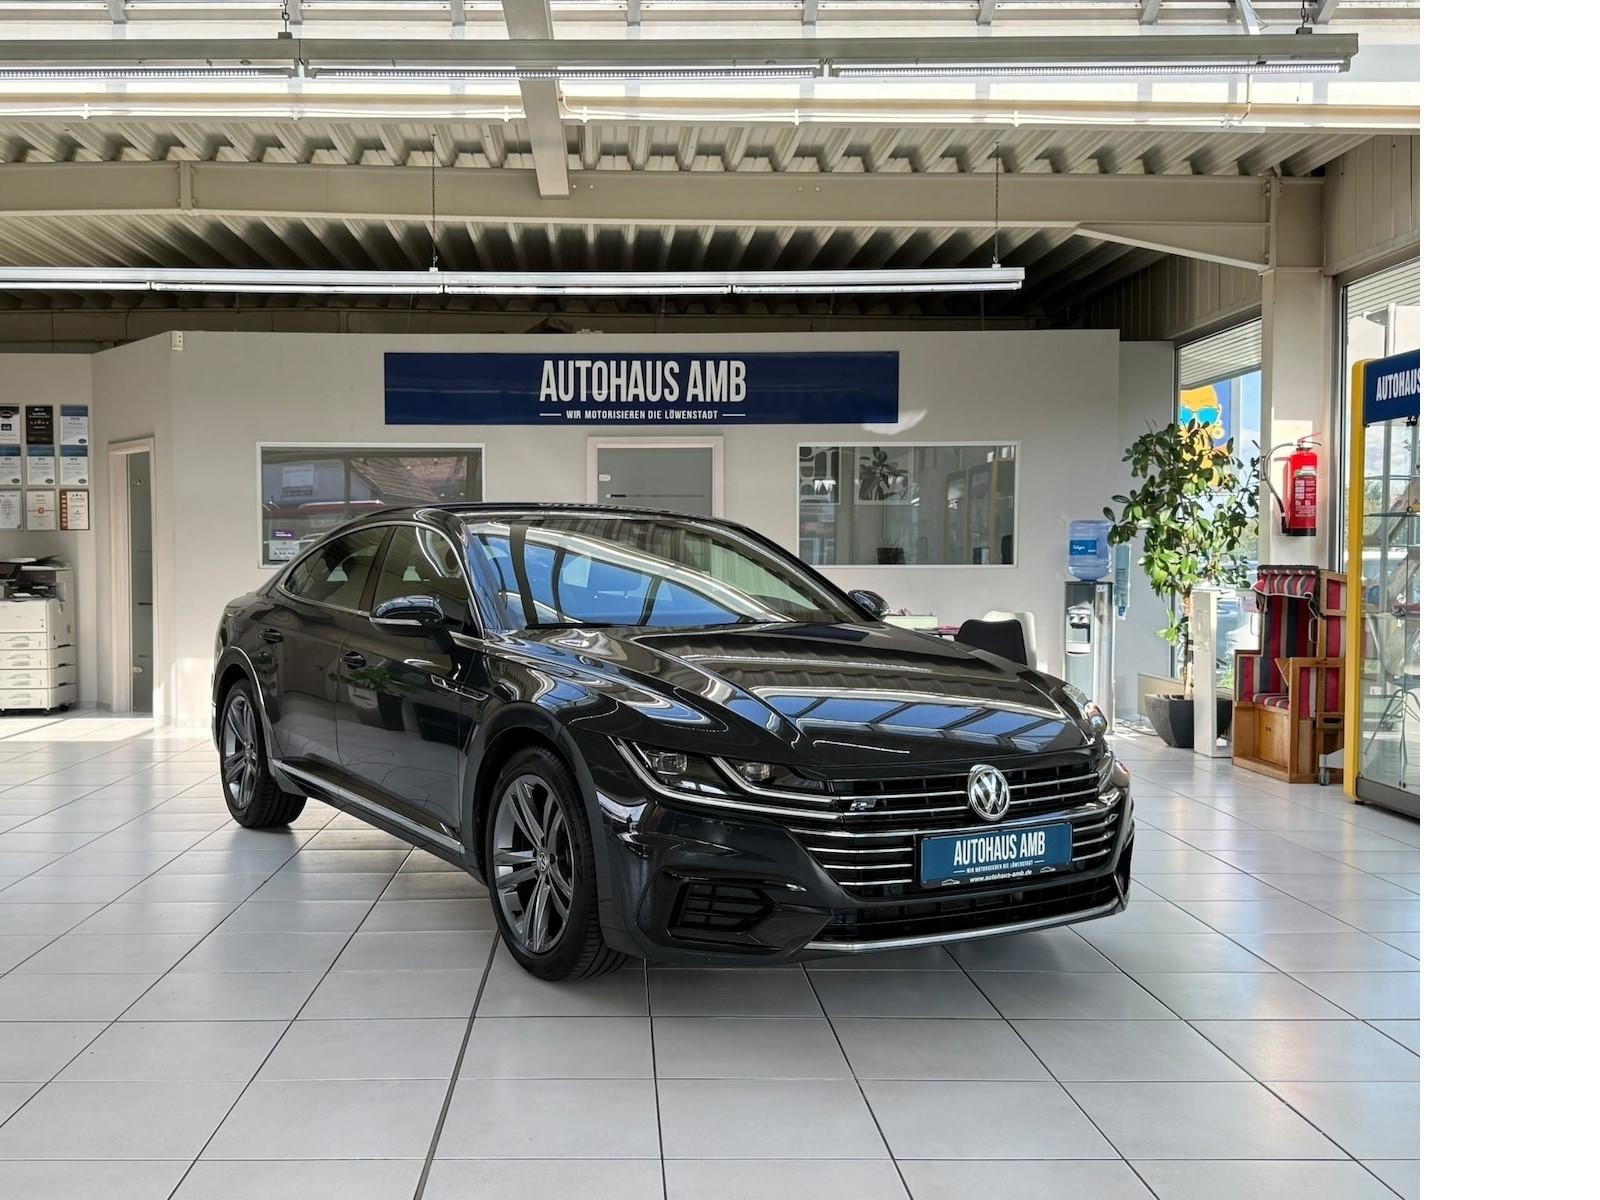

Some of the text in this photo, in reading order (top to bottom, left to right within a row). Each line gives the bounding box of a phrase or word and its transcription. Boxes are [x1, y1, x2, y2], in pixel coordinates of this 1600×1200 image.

[539, 360, 747, 402] AUTOHAUS AMB
[566, 408, 718, 420] WIR MOTORISIEREN DIE LÖWENSTADT
[953, 831, 1046, 866] AUTOHAUS AMB
[969, 869, 1032, 882] www.autohaus-amb.de
